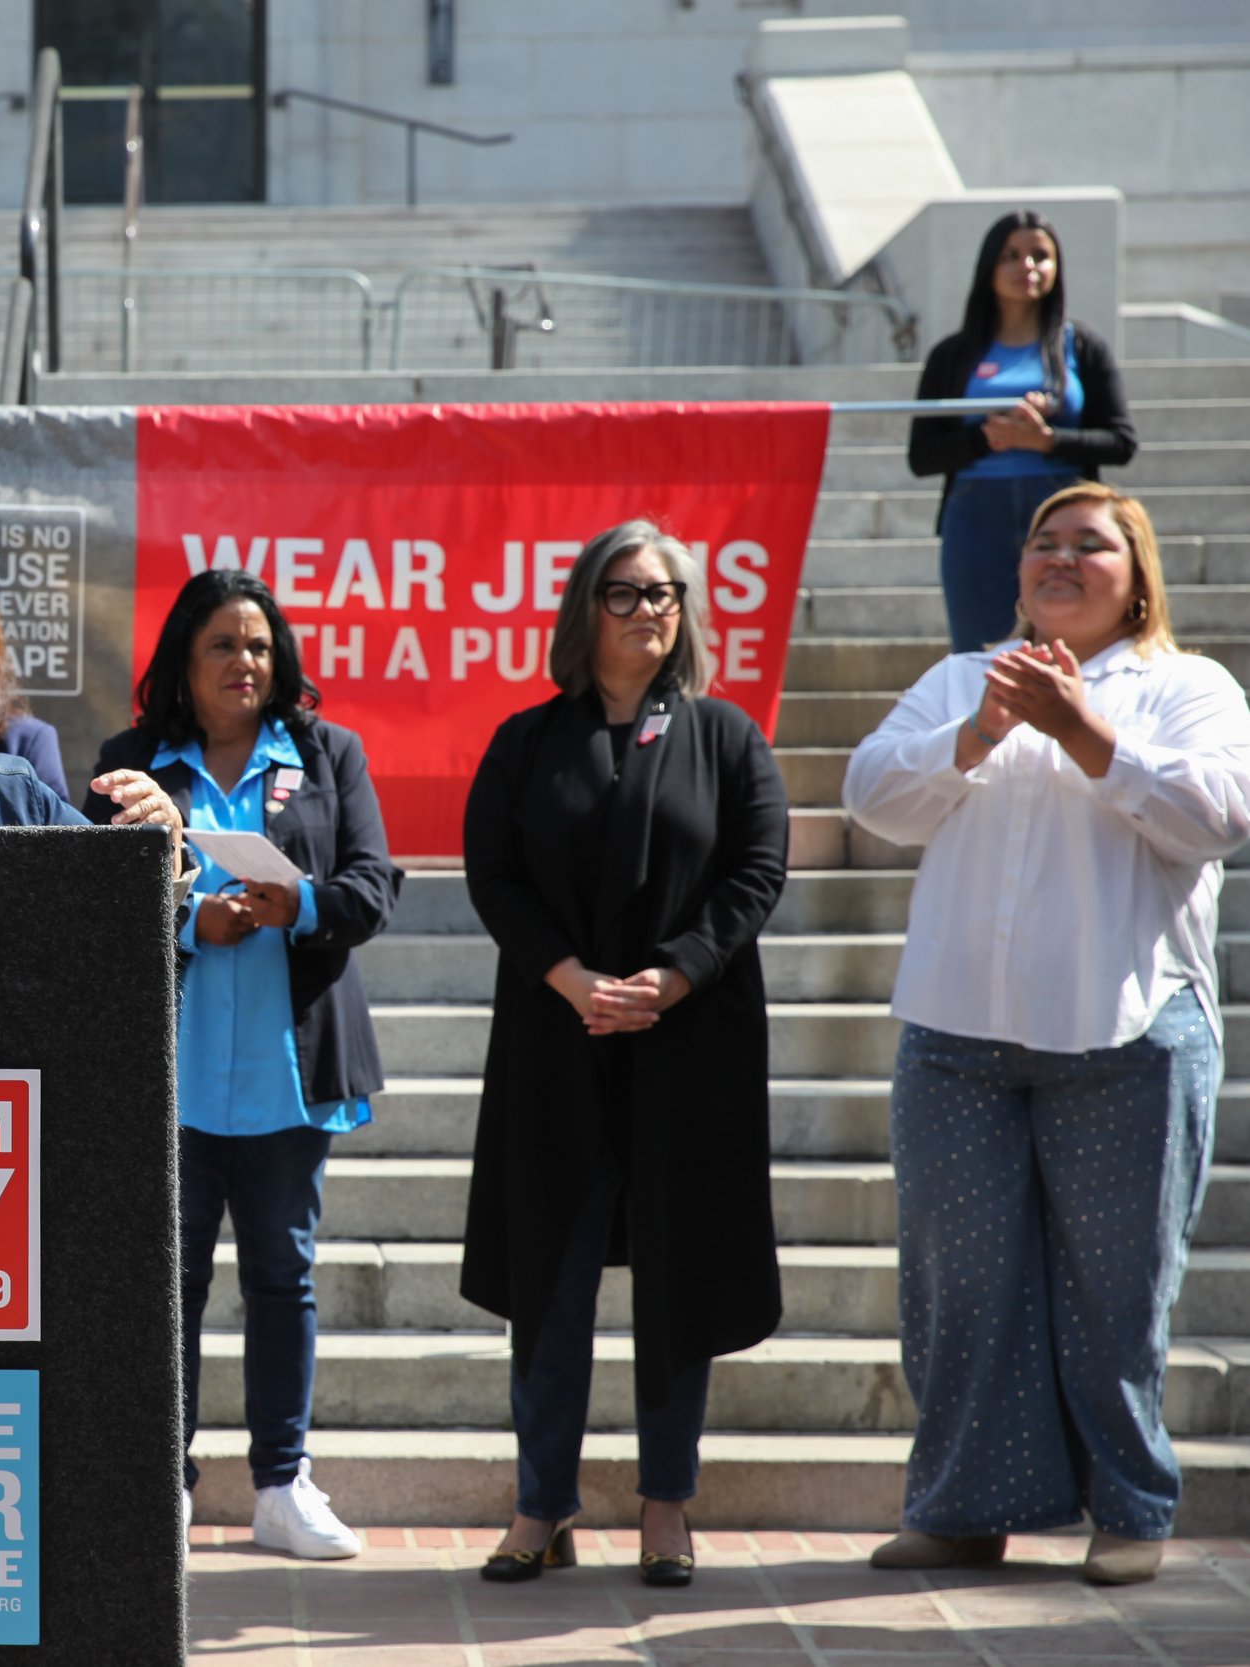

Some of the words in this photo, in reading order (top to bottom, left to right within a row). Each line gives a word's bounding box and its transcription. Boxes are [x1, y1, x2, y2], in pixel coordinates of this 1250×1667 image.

[1, 525, 25, 548] IS
[33, 526, 71, 549] NO
[181, 534, 446, 610] WEAR
[471, 540, 769, 613] JES
[384, 626, 429, 680] A
